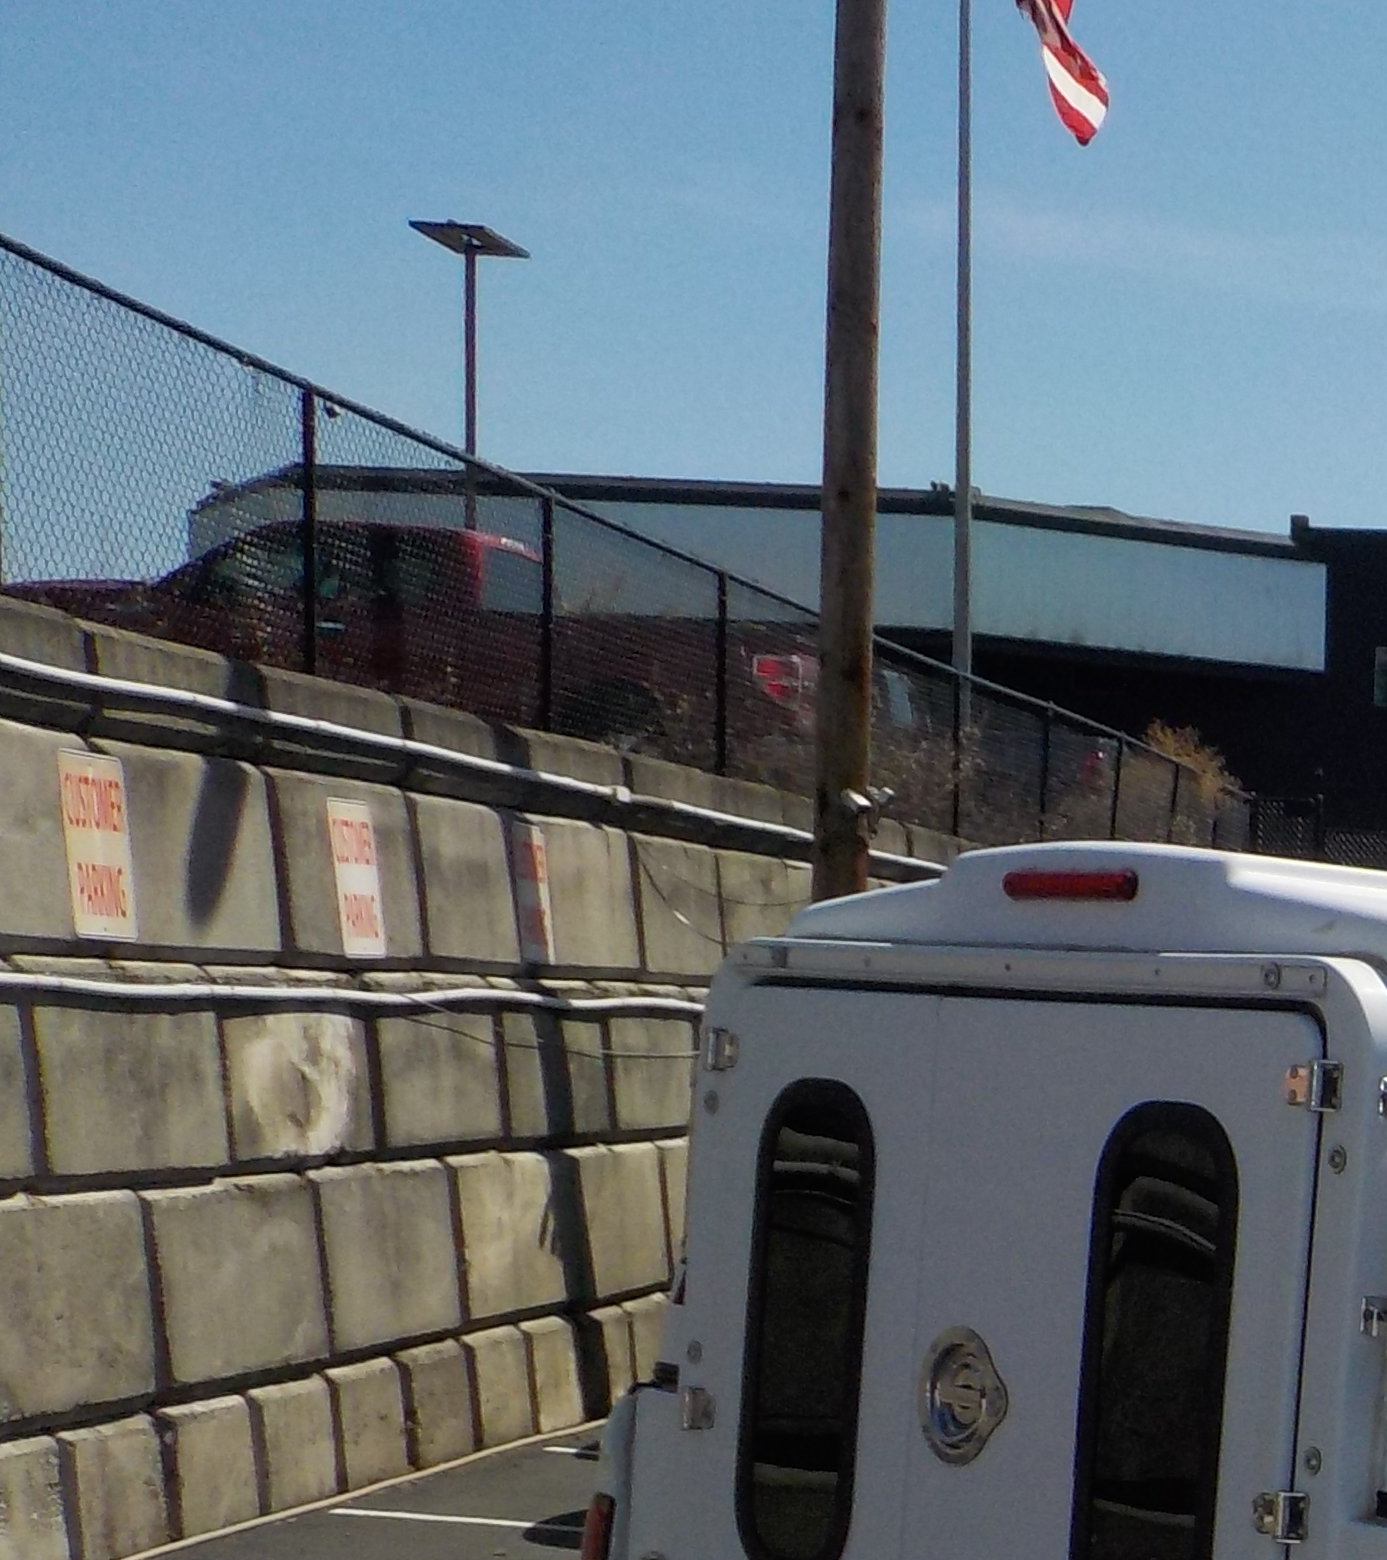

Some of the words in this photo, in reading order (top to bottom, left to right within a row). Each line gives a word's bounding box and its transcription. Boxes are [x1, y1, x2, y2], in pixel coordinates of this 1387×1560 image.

[64, 772, 124, 832] CUSTOMER
[332, 818, 376, 866] CUSTOMER
[76, 862, 127, 918] PARKING
[343, 893, 380, 939] PARKING
